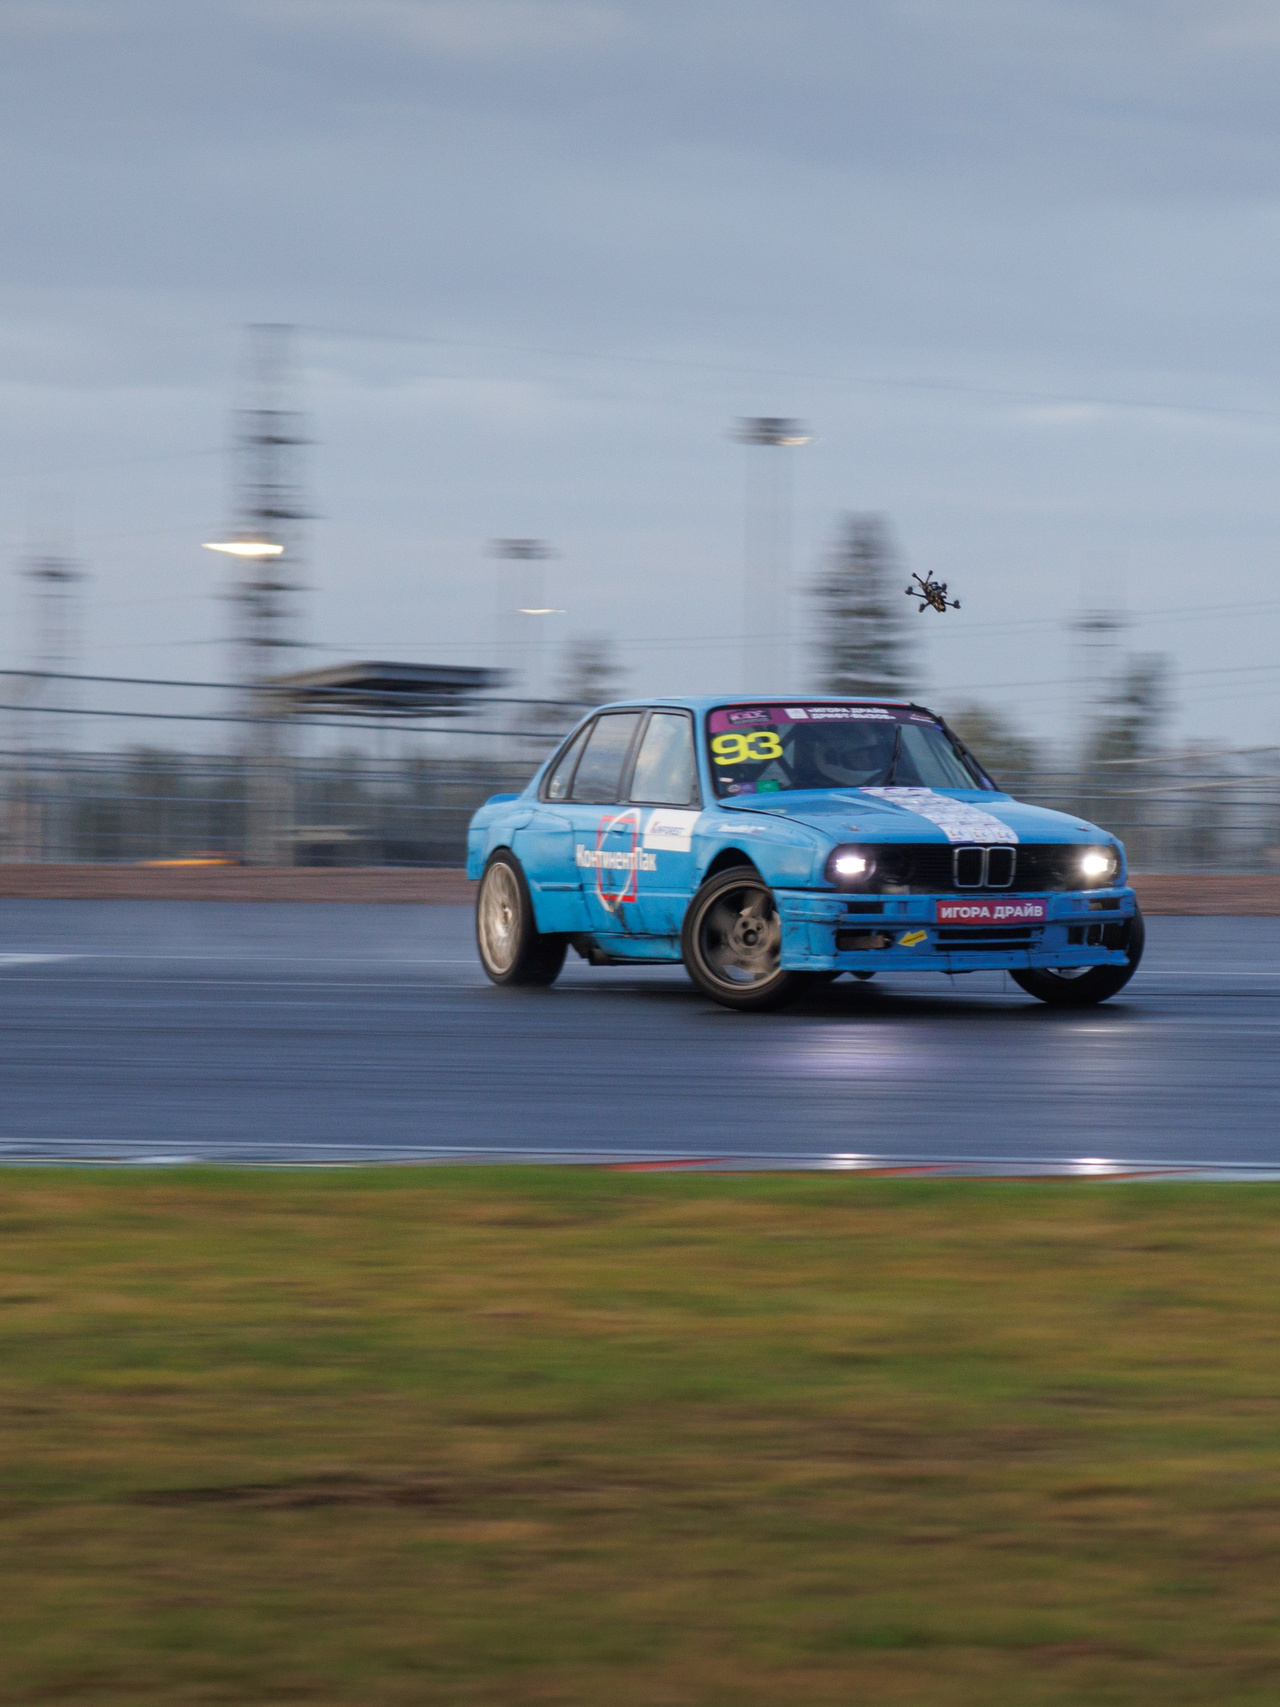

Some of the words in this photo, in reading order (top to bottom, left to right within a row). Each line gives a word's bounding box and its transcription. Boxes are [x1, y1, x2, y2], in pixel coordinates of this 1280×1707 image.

[711, 731, 783, 765] 93
[576, 843, 657, 871] КонтинентПак
[941, 906, 990, 918] ИГОРА
[993, 903, 1043, 919] ДРАЙВ
